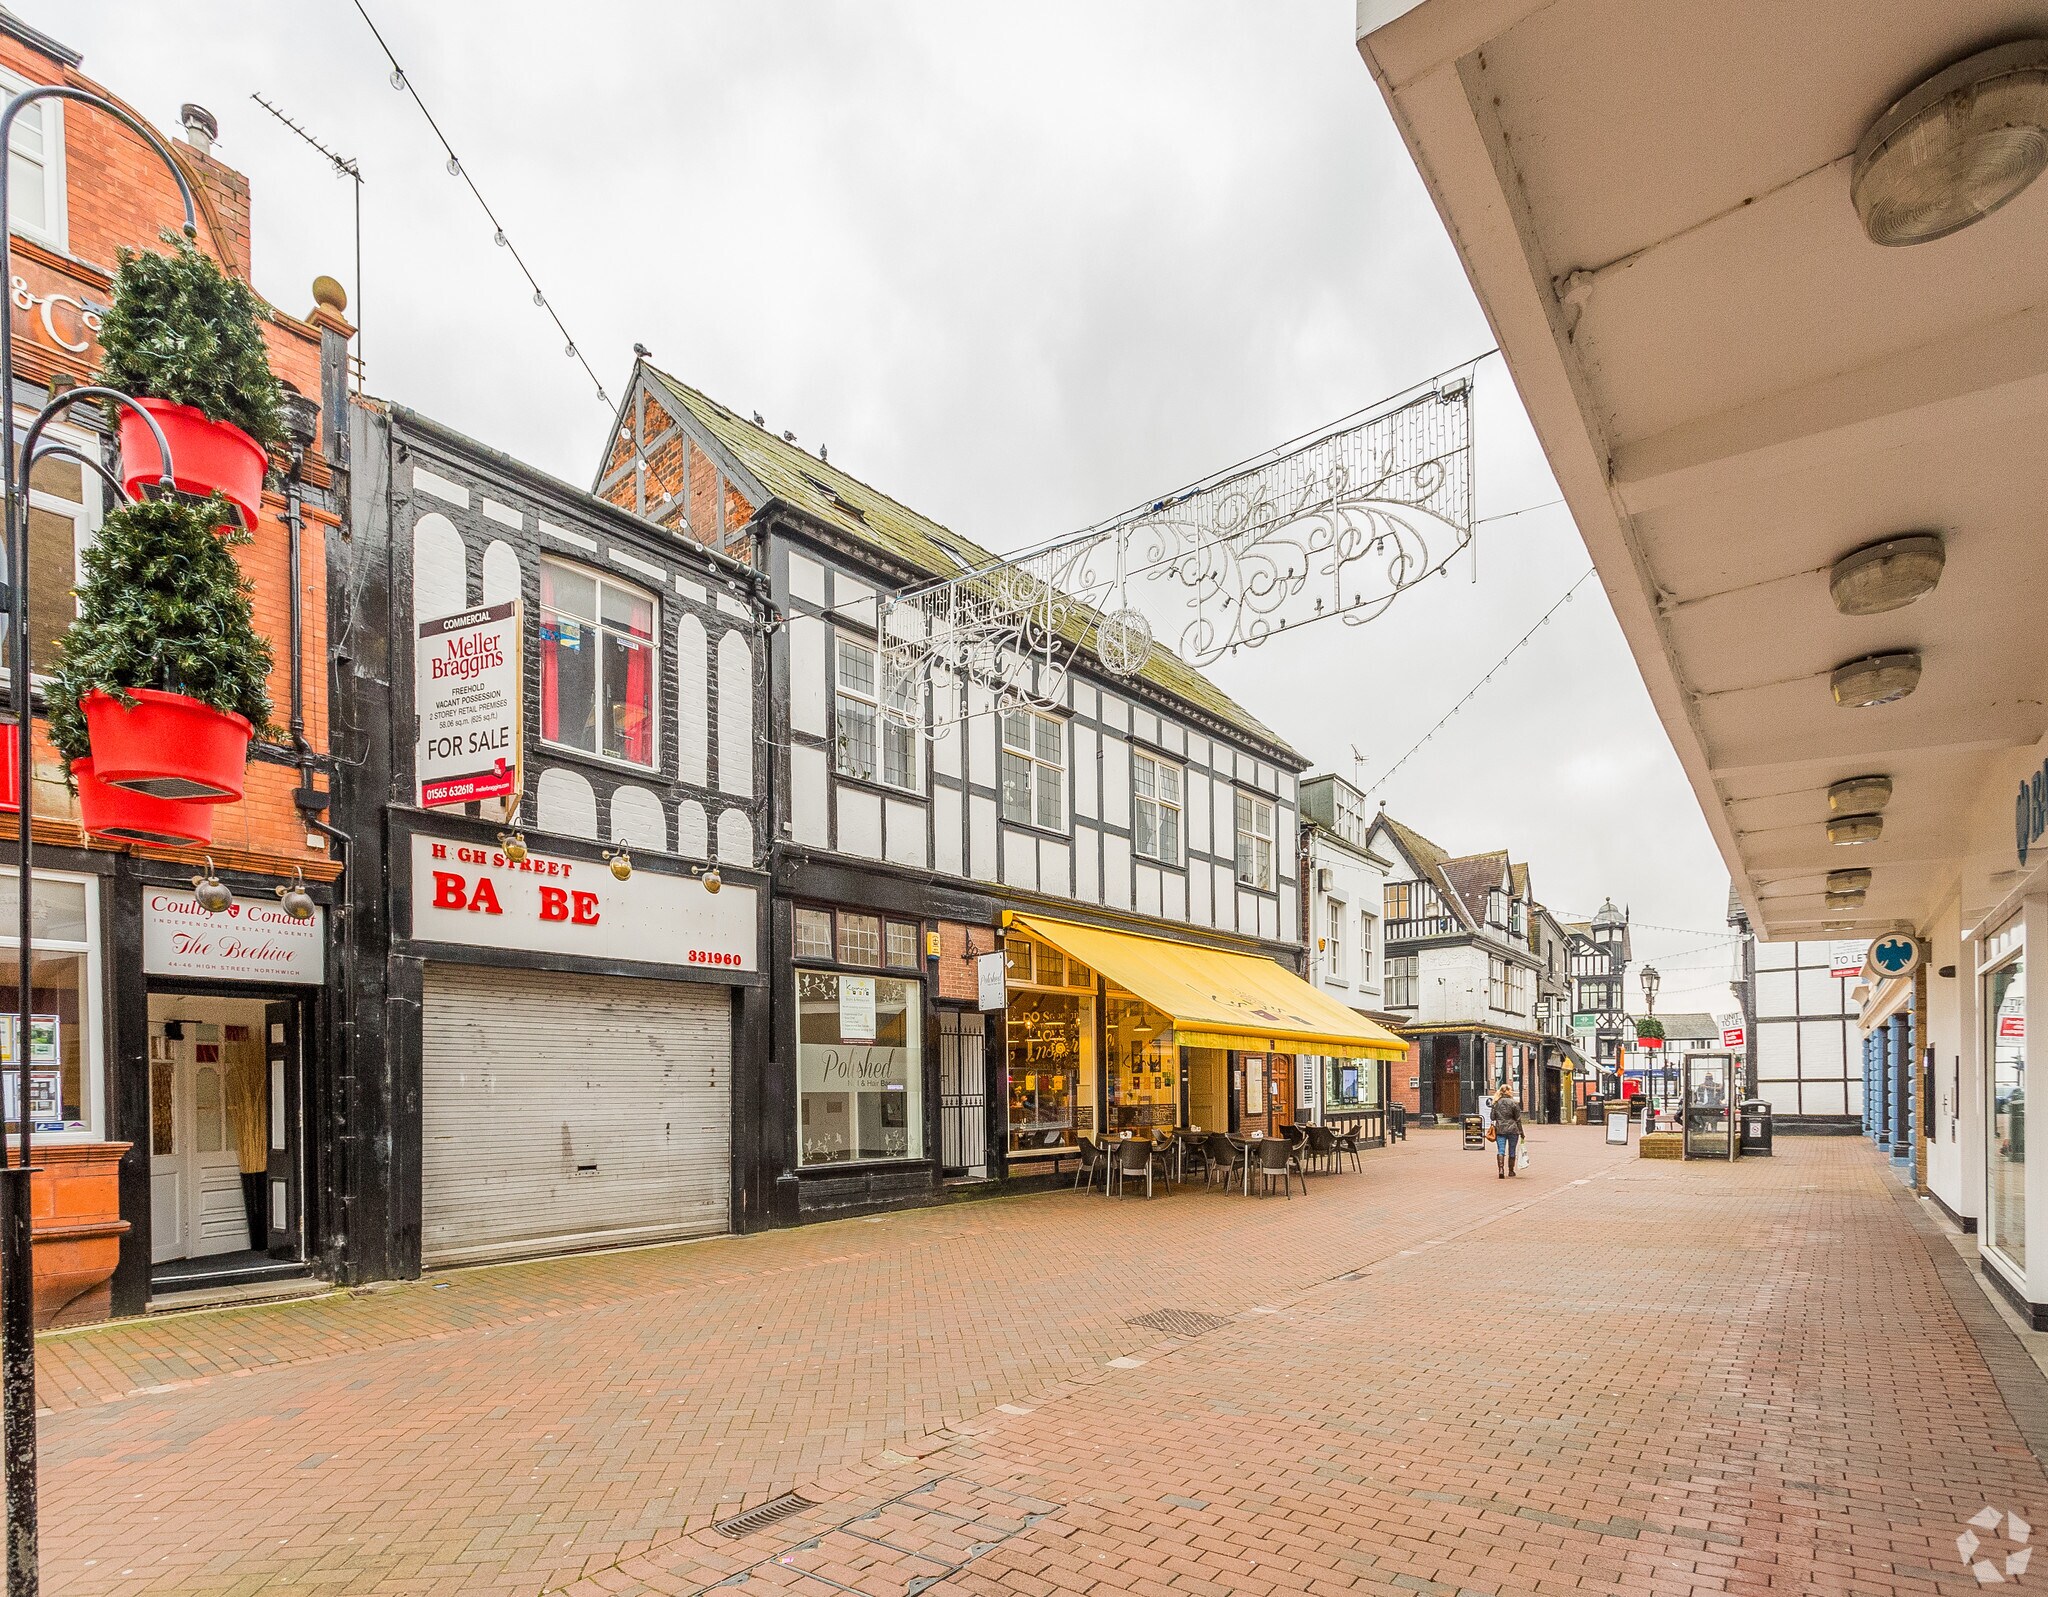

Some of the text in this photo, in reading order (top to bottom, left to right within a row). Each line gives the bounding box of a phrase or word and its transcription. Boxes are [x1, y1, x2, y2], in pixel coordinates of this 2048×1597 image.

[443, 611, 491, 629] COMMERCIAL
[447, 632, 500, 661] Meller
[431, 650, 504, 680] Braggins
[451, 682, 485, 696] FREEHOLD
[434, 708, 457, 720] STOREY
[458, 705, 477, 715] RETAIL
[478, 698, 508, 711] PREMISES
[435, 690, 501, 709] VACANT POSSESSION
[428, 726, 509, 761] FOR SALE
[426, 787, 448, 800] 01565
[448, 783, 474, 798] 632618
[153, 917, 314, 938] INDEPENDENT ESTATE AGENTS
[171, 929, 298, 963] The Beehive
[688, 950, 743, 967] 331960
[1833, 955, 1848, 965] TO
[168, 961, 192, 969] 44-46
[220, 965, 251, 973] STREET
[254, 967, 301, 976] NORTHWICH
[1723, 1012, 1740, 1021] UNIT
[822, 1047, 896, 1083] Polished
